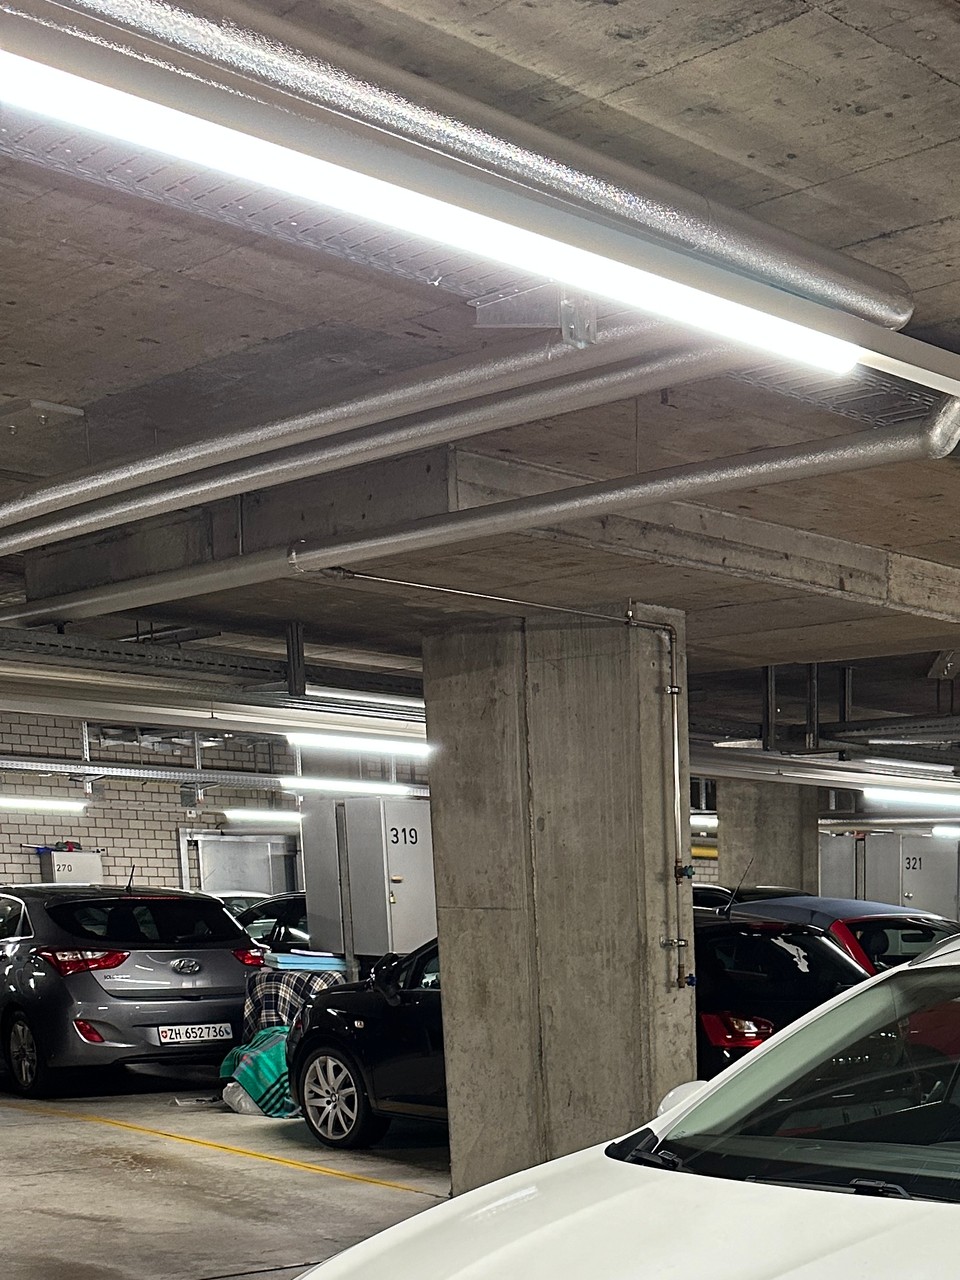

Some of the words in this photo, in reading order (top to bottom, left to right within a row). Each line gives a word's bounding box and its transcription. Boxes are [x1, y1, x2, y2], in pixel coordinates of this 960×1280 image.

[390, 827, 418, 845] 319
[56, 863, 73, 873] 270
[905, 856, 922, 870] 321
